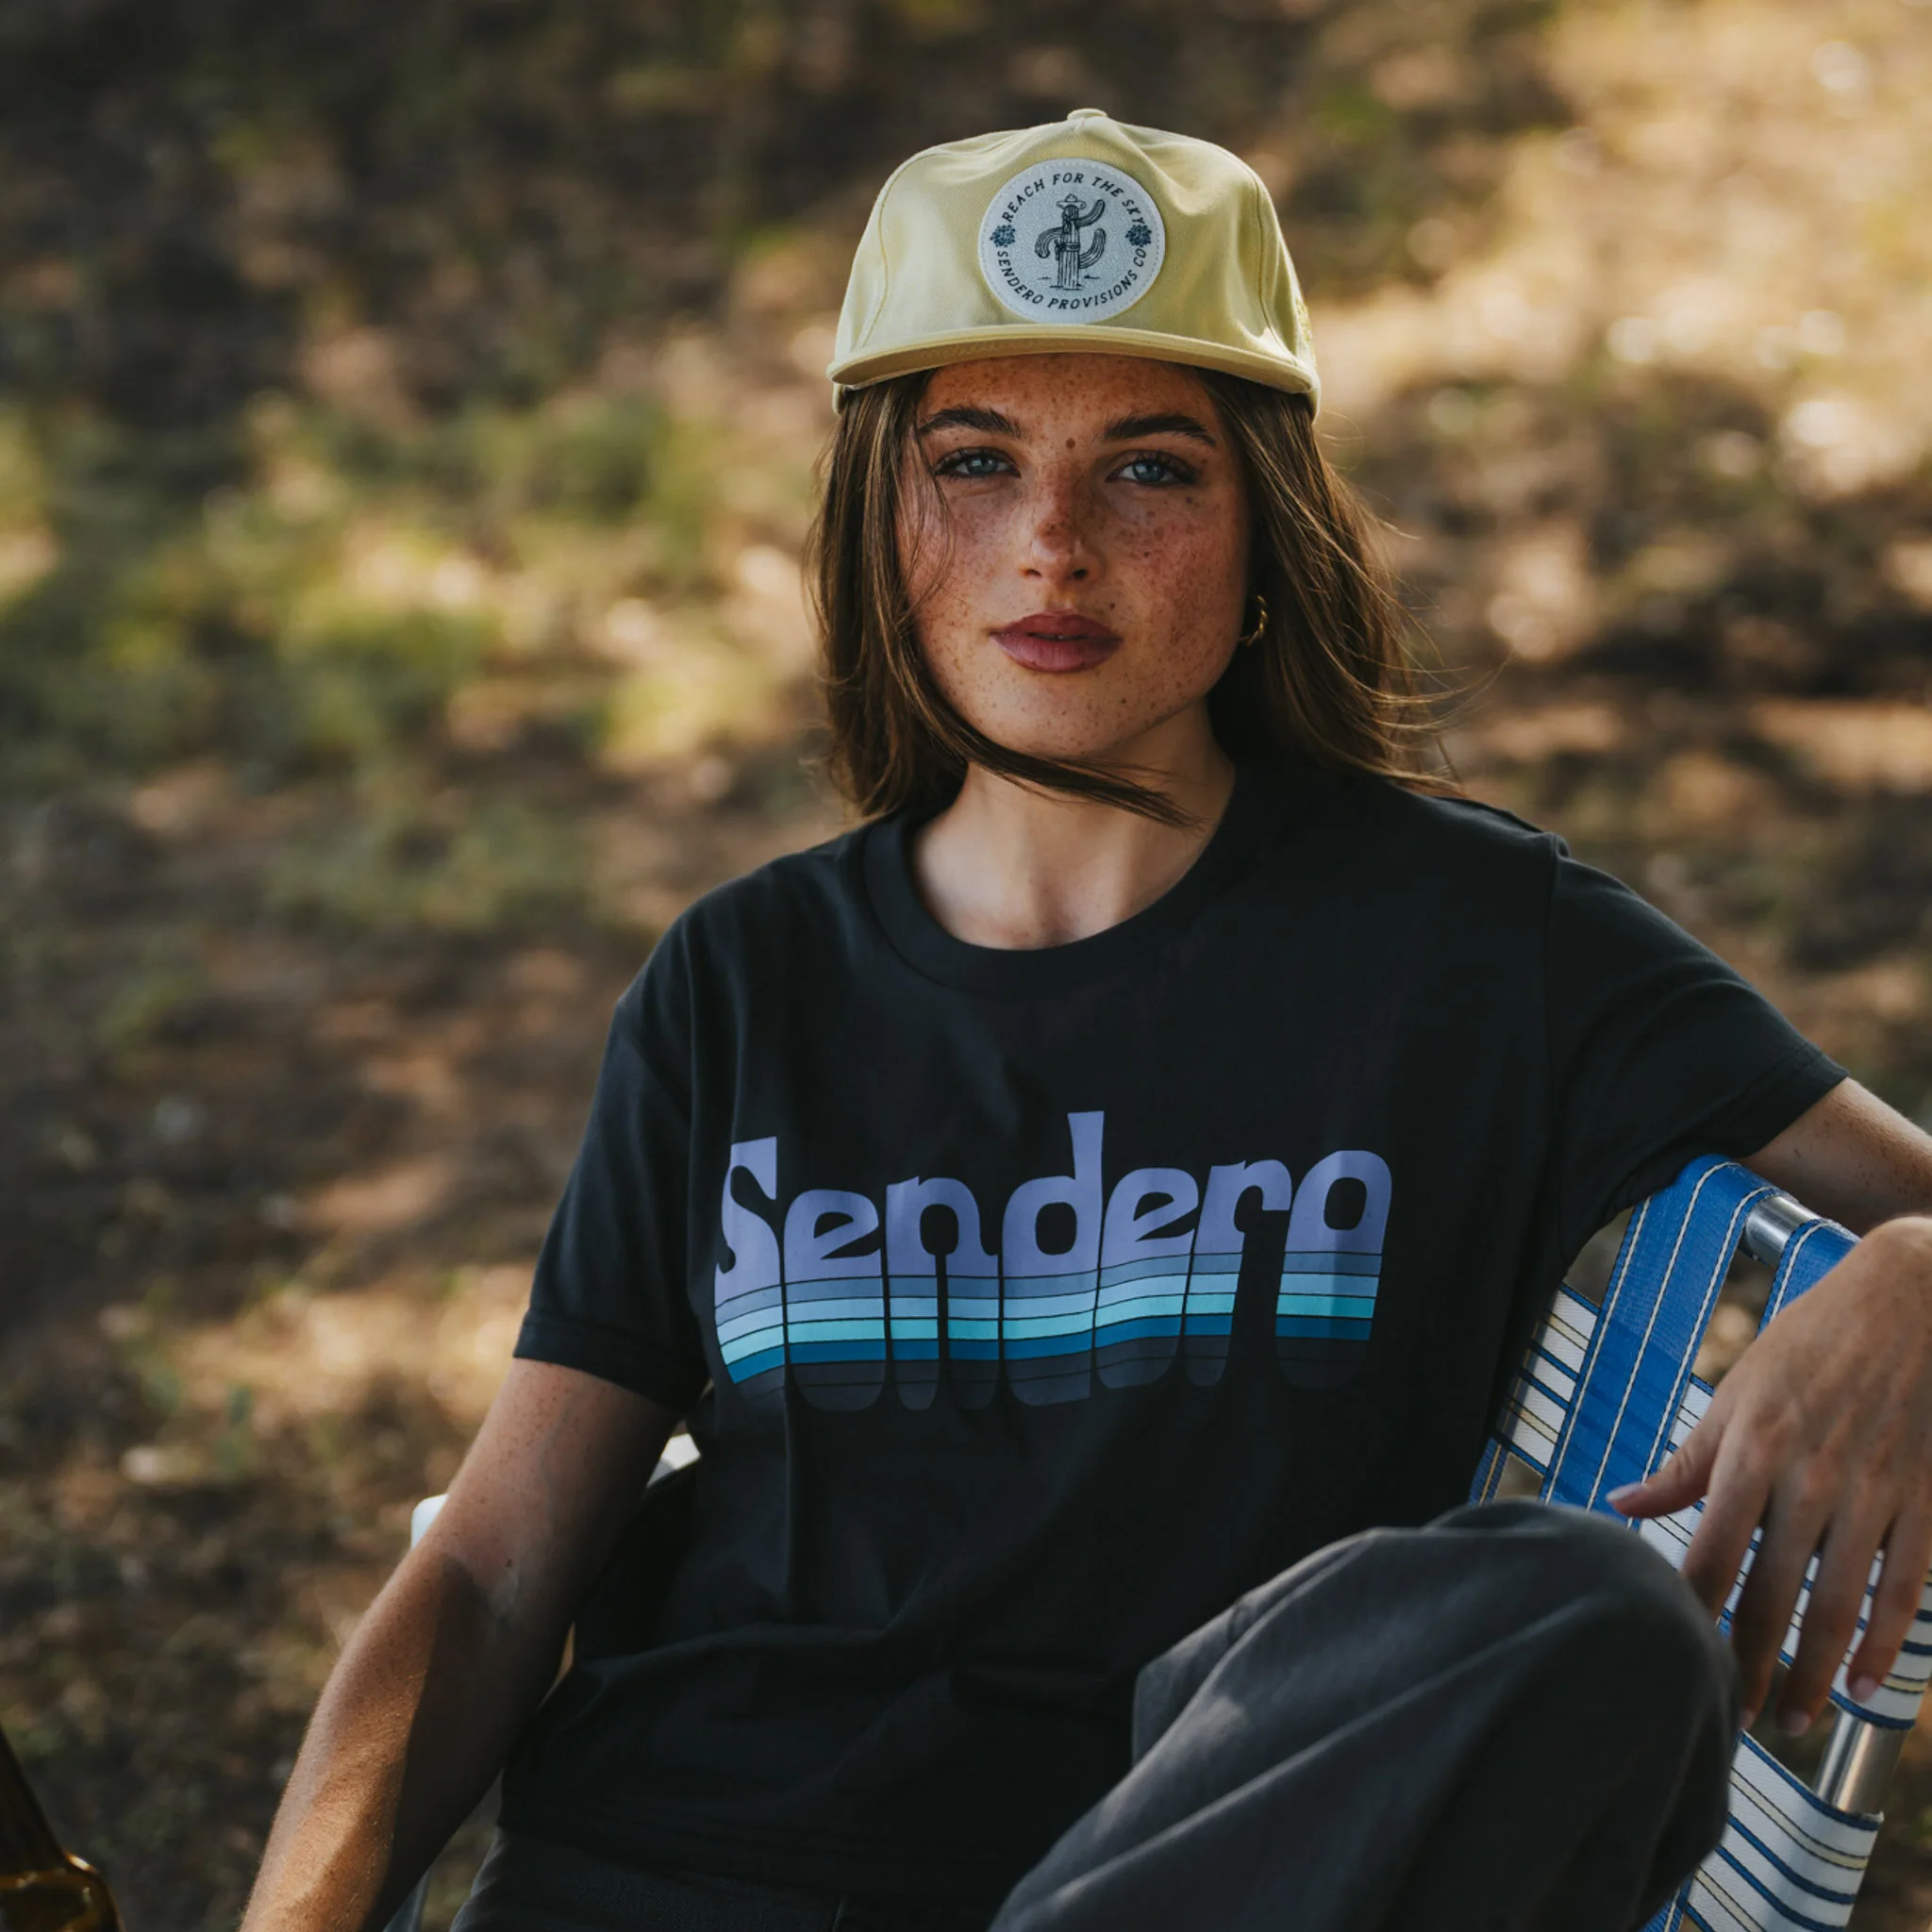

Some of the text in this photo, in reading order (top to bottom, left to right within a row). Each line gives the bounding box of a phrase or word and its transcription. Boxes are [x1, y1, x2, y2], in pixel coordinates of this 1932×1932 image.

[1002, 173, 1145, 225] REACH FOR THE SKY
[997, 250, 1043, 304] SENDERO
[1047, 270, 1138, 309] PROVISIONS
[714, 1110, 1392, 1394] Sendero
